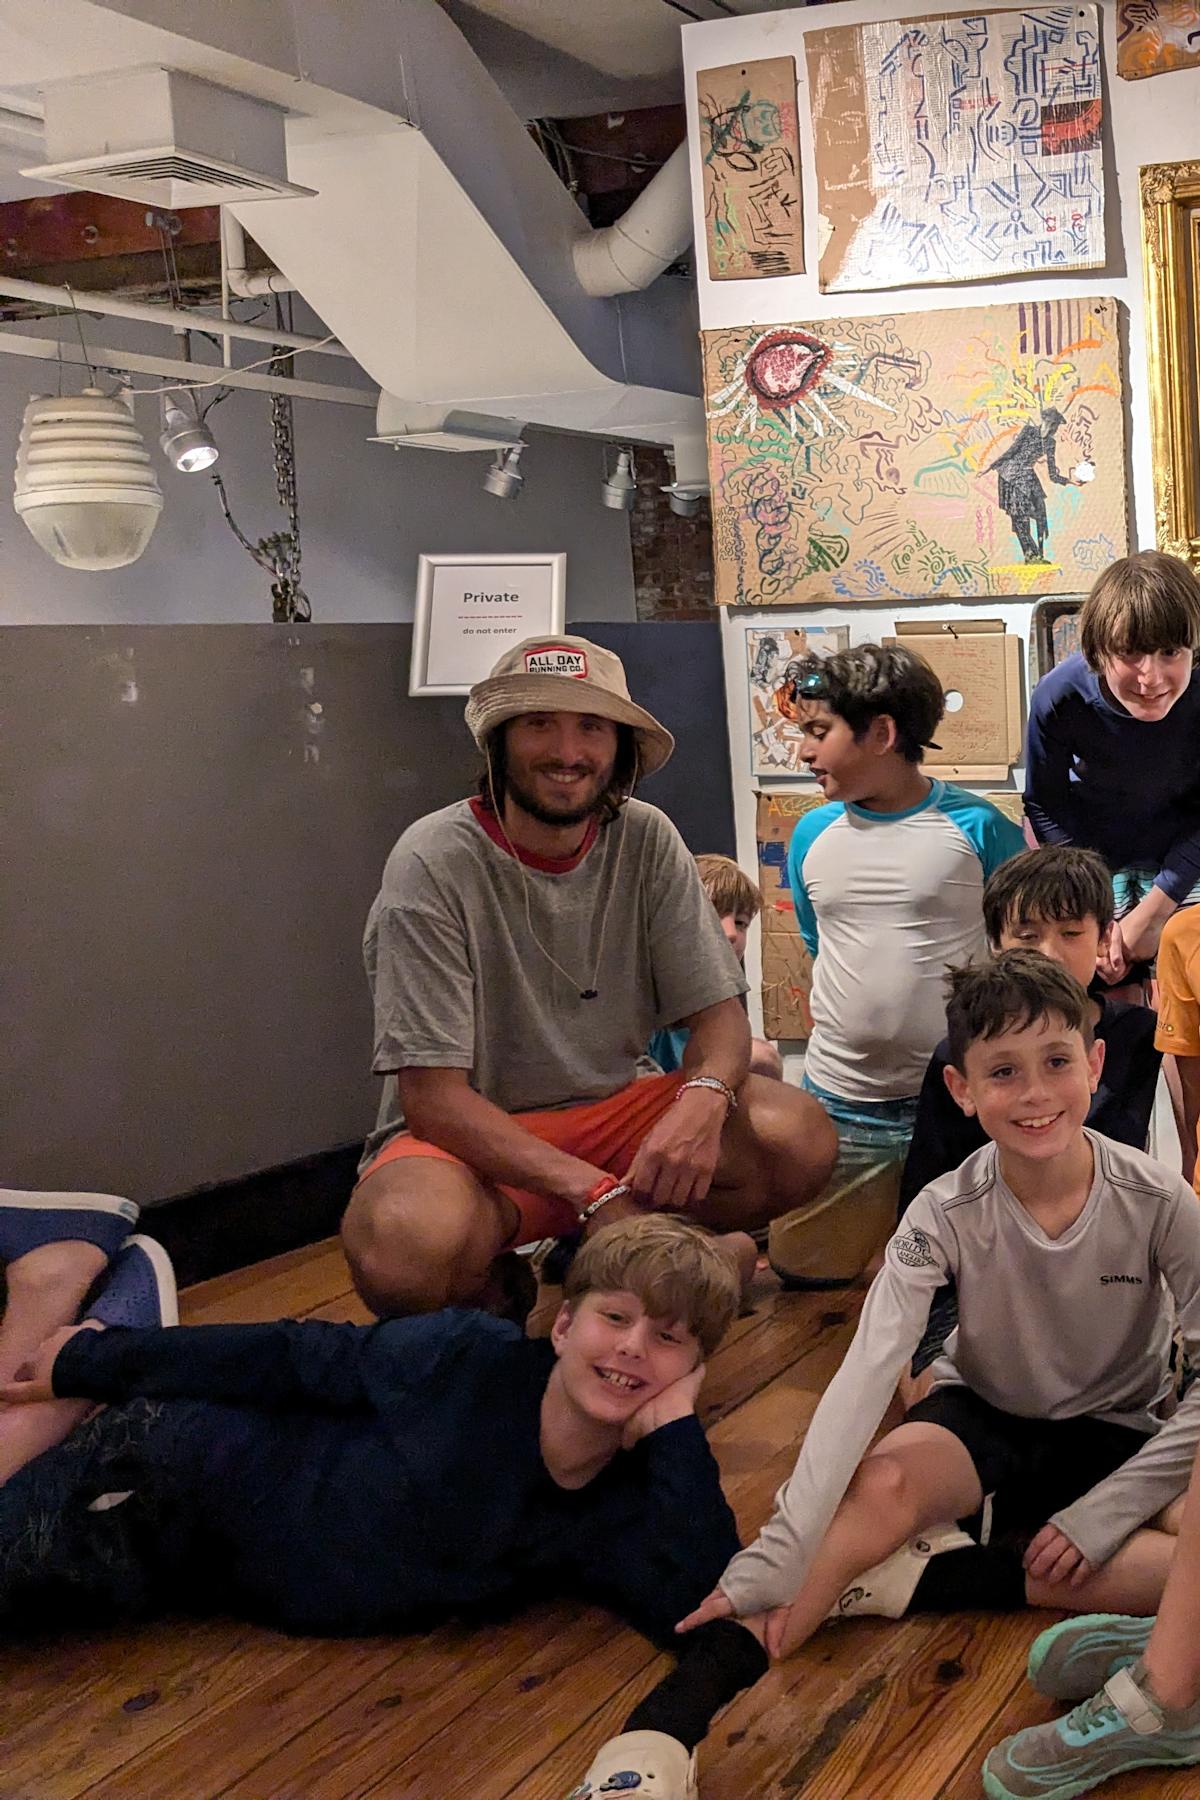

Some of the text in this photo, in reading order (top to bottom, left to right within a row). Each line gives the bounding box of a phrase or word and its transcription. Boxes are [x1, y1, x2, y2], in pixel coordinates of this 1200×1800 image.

[463, 592, 520, 603] Private
[529, 655, 581, 666] ALL DAY
[529, 665, 568, 673] RUNNING
